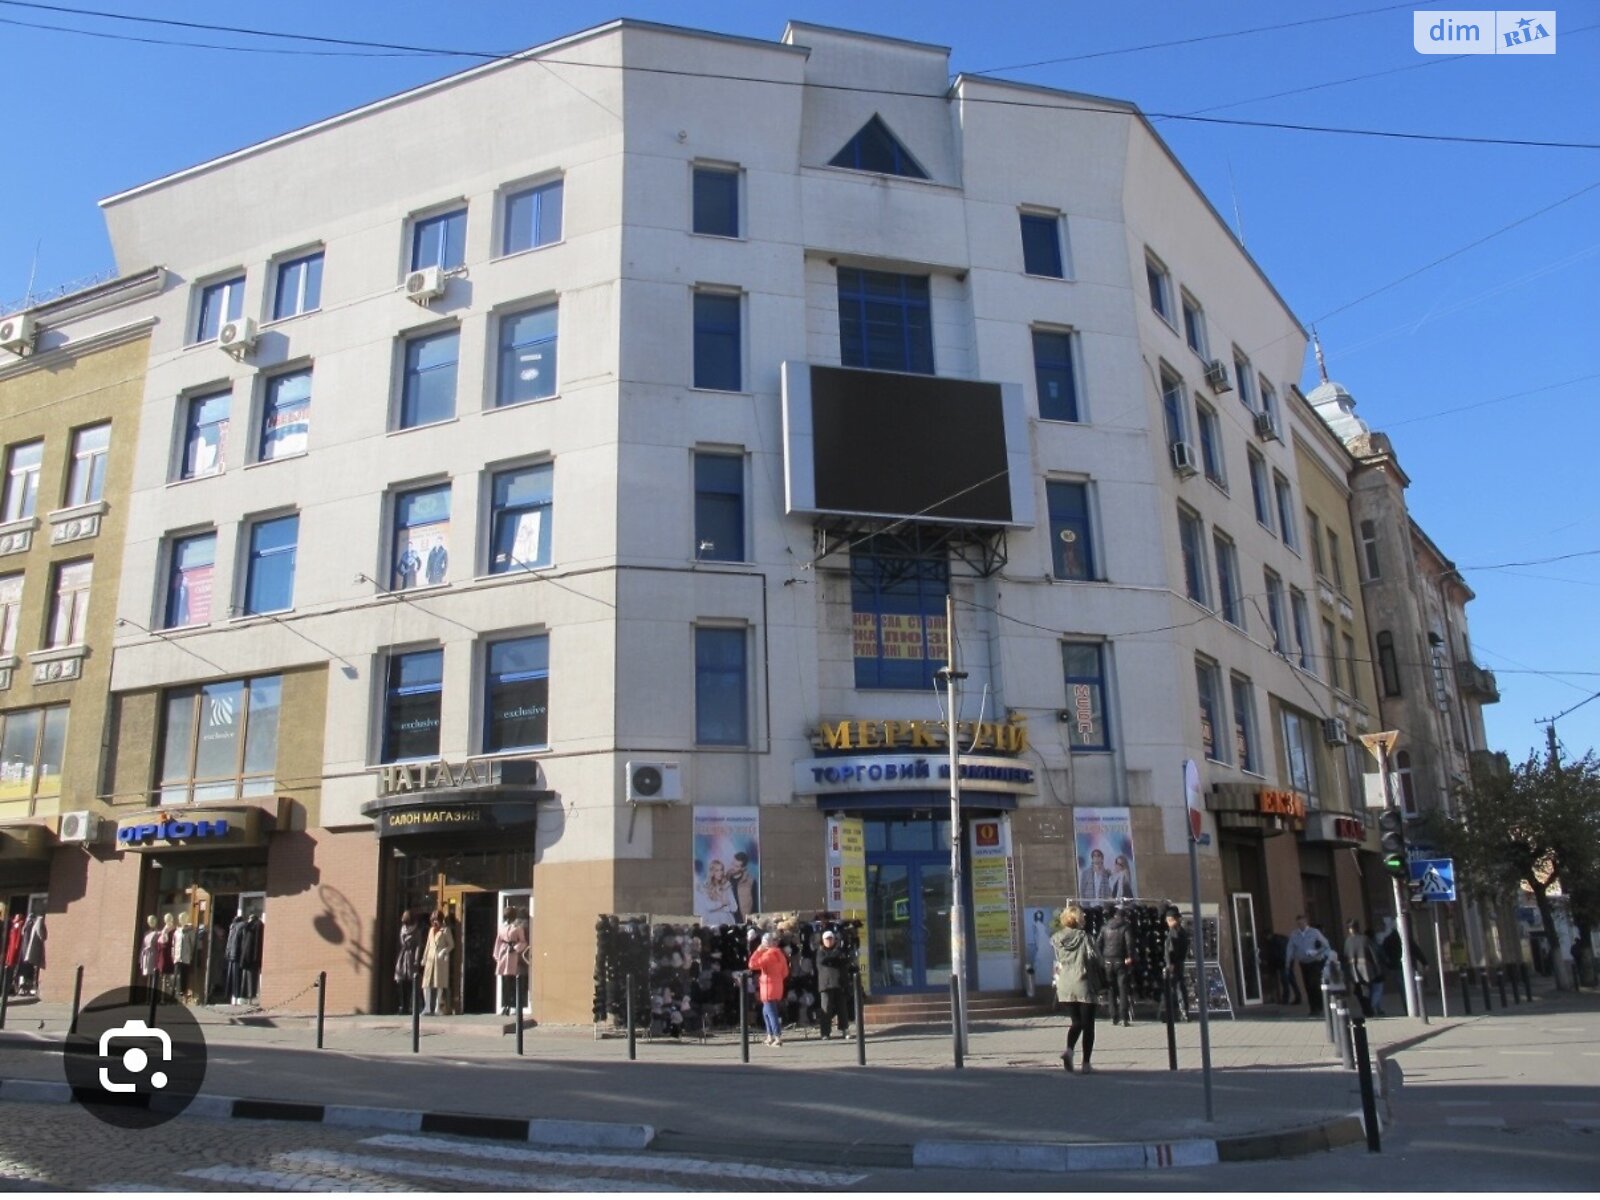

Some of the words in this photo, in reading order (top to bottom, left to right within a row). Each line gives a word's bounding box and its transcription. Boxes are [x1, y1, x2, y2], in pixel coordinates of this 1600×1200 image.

[503, 704, 546, 719] exclusive
[811, 758, 930, 784] ТОРГОВИЙ
[389, 812, 420, 827] САЛОН
[422, 810, 480, 824] МАГАЗИН
[118, 818, 229, 842] ОРІОН
